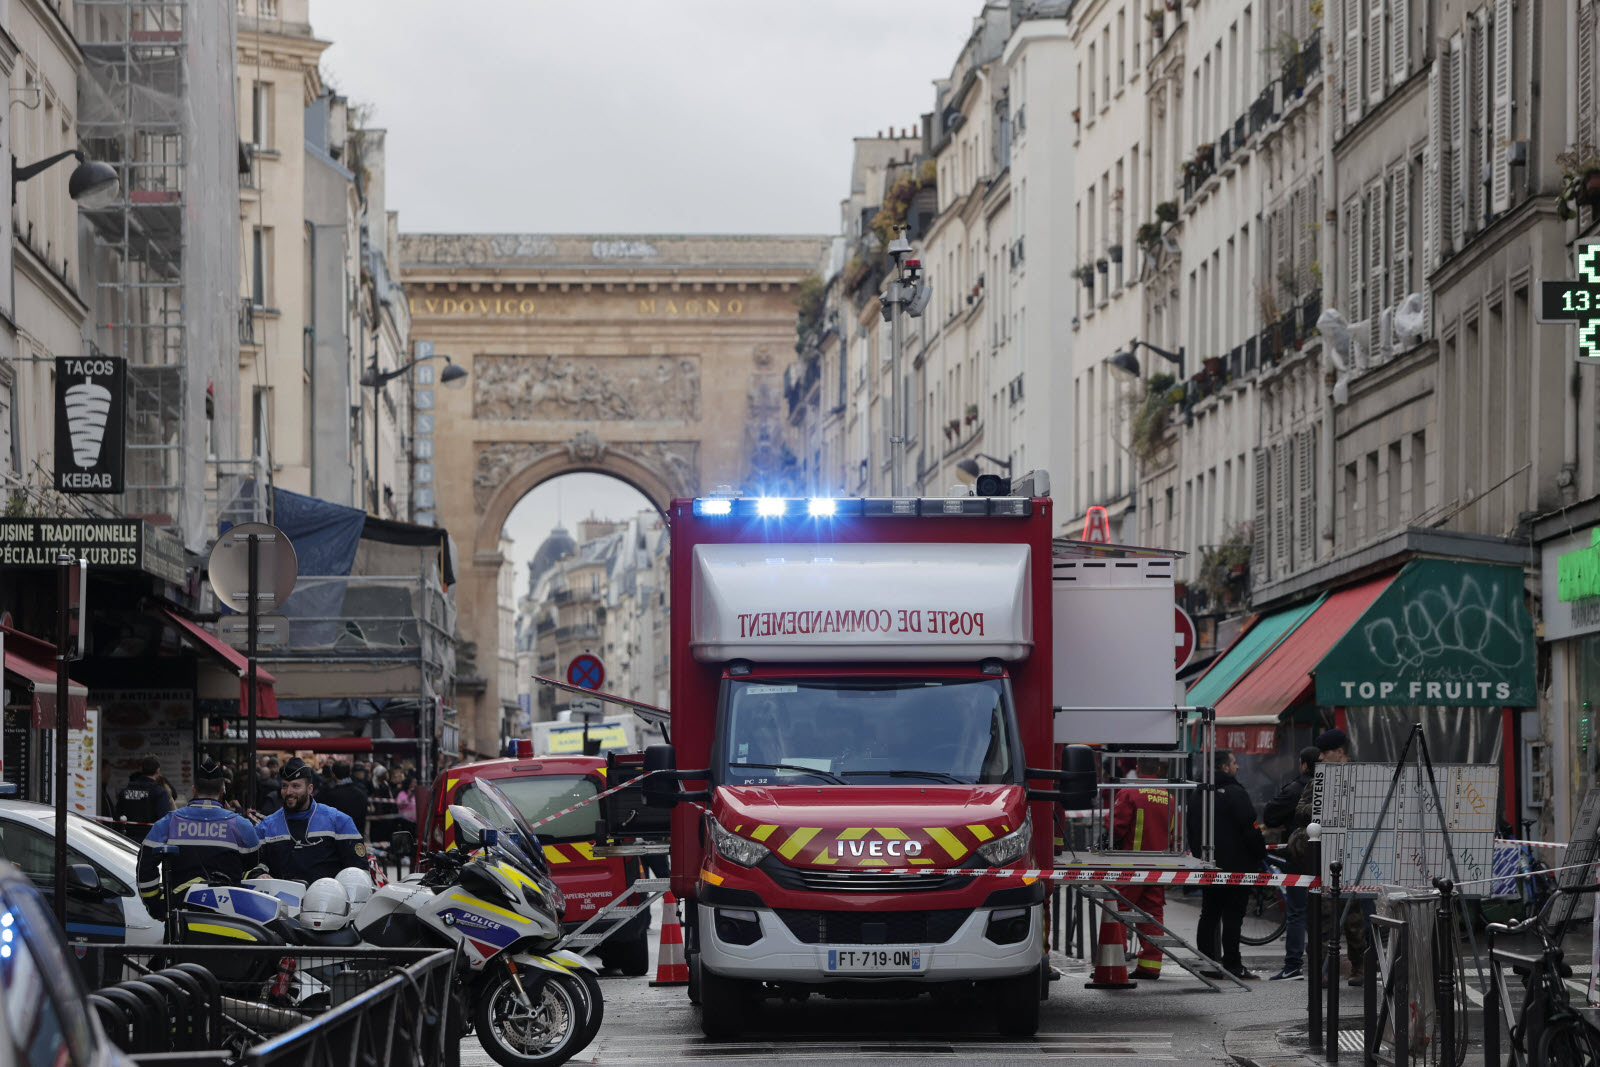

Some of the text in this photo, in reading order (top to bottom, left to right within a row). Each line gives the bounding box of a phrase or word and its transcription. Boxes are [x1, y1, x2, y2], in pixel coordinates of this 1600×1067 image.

[410, 298, 744, 315] LVDOVICO MAGNO
[65, 360, 114, 376] TACOS
[62, 474, 112, 489] KEBAB
[41, 524, 137, 542] TRADITIONNELLE
[81, 547, 137, 564] KURDES
[1341, 682, 1510, 699] TOP FRUITS
[124, 789, 149, 800] POLICE
[1148, 794, 1169, 805] PARIS
[1313, 772, 1324, 815] MOYENS
[1463, 783, 1486, 814] ZDI
[178, 821, 227, 839] POLICE
[837, 840, 922, 857] IVECO
[1460, 849, 1482, 881] SAN
[217, 895, 230, 904] 17
[563, 891, 613, 900] SAPEURS-POMPIERS
[463, 912, 501, 930] POLICE
[839, 951, 910, 966] FT-719-QN
[912, 958, 920, 966] 75
